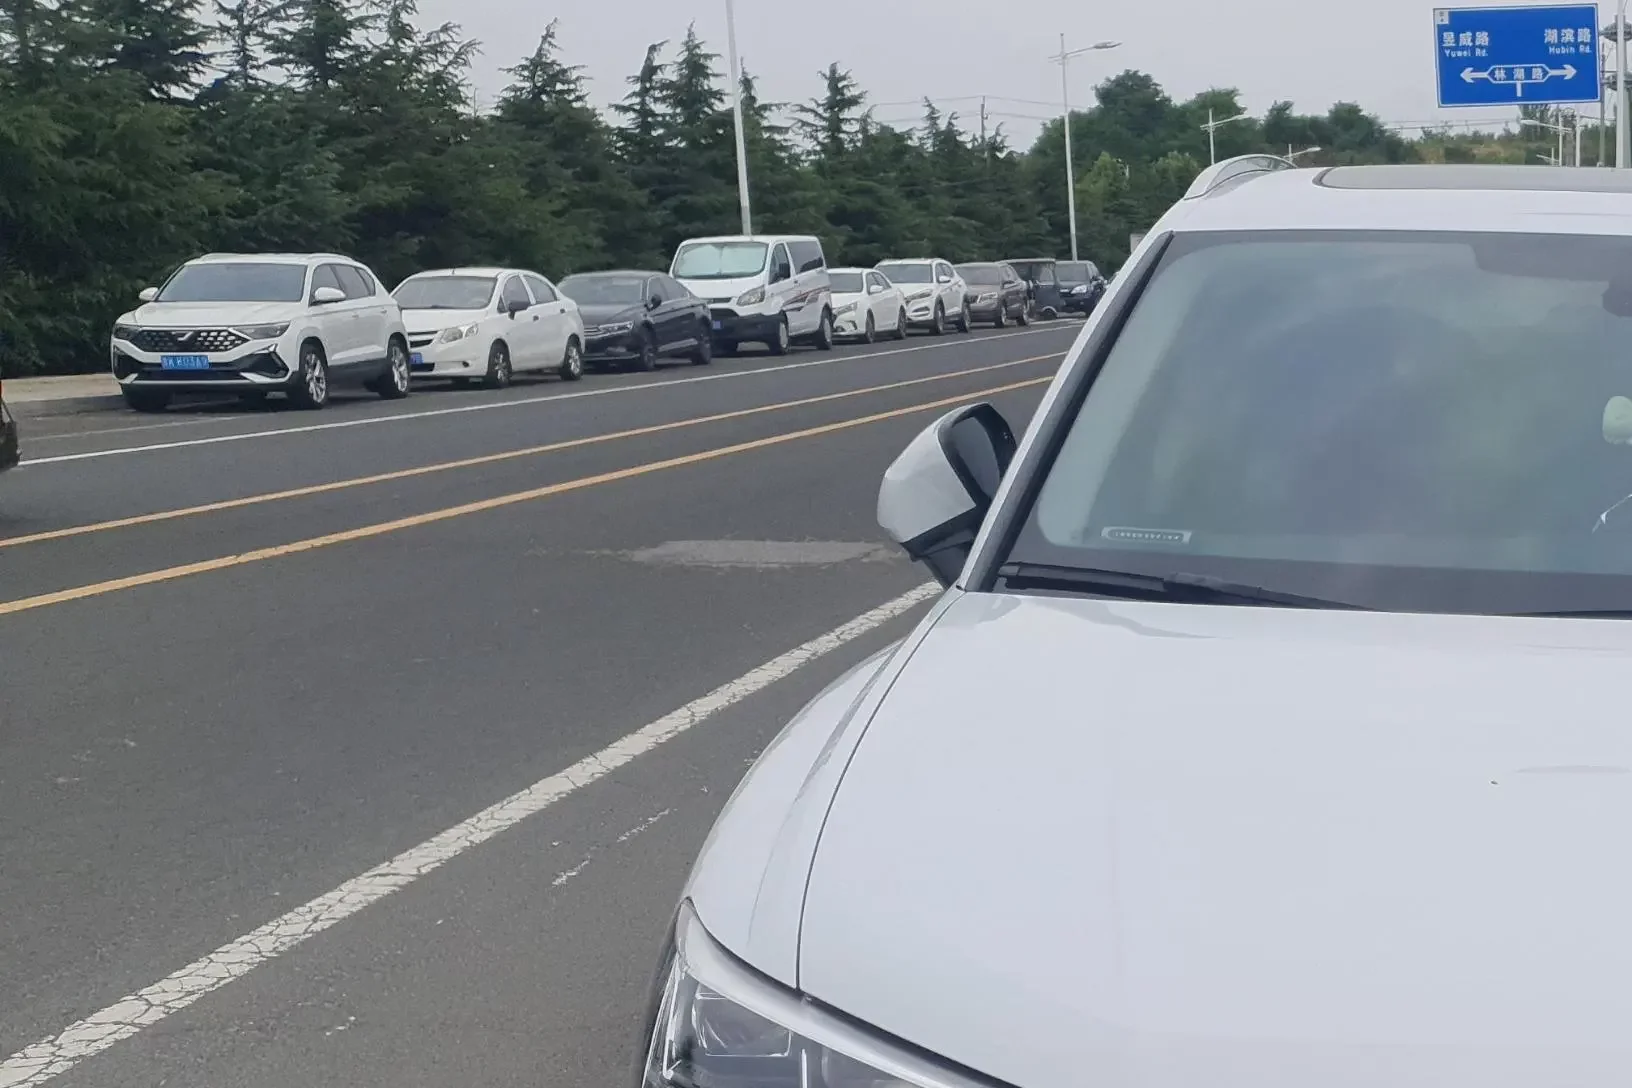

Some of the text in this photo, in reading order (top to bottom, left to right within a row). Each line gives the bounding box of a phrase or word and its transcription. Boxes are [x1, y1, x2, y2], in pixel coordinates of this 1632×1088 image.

[1544, 27, 1591, 44] 湖滨路
[1444, 47, 1489, 58] Yuwei Rd.
[1548, 45, 1576, 55] Hubin
